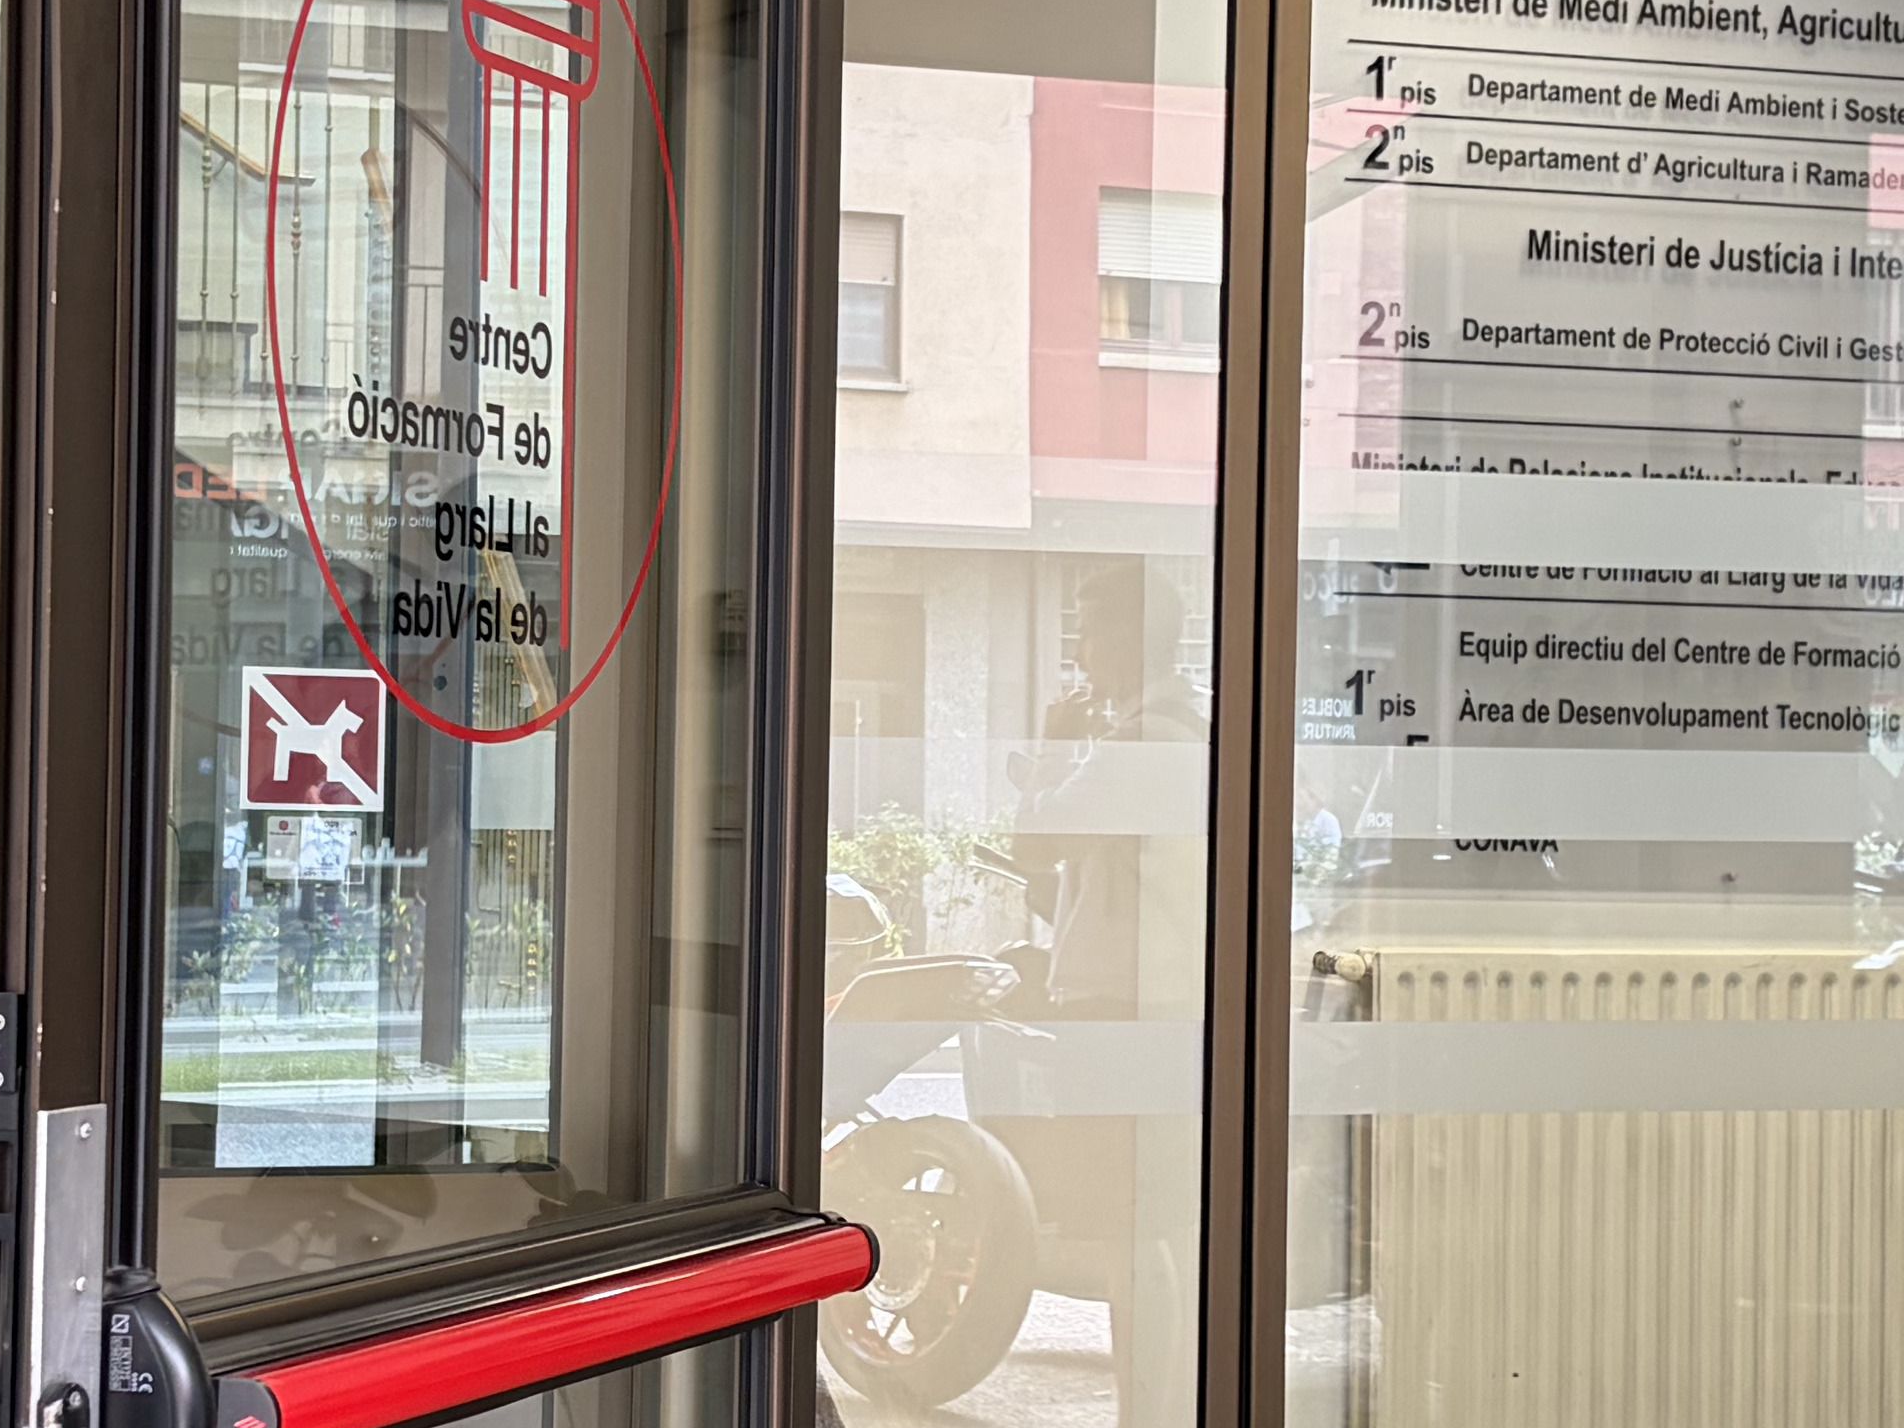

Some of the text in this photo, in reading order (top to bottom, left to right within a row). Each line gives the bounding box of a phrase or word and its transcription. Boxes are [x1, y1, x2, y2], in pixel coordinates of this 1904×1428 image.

[1400, 81, 1437, 108] pis
[1468, 74, 1621, 106] Departament
[1629, 85, 1656, 108] de
[1665, 87, 1719, 113] Medi
[1727, 92, 1824, 120] Ambient
[1832, 98, 1837, 120] i
[1399, 149, 1434, 175] pis
[1466, 141, 1620, 174] Departament
[1654, 153, 1784, 183] Agricultura
[1793, 161, 1797, 183] i
[1527, 229, 1655, 266] Ministeri
[1665, 237, 1700, 269] de
[1709, 240, 1823, 276] Justícia
[1834, 246, 1840, 276] i
[1395, 326, 1430, 351] pis
[1462, 318, 1616, 348] Departament
[1623, 327, 1651, 350] de
[1660, 328, 1770, 355] Protecció
[1778, 334, 1828, 359] Civil
[1836, 337, 1841, 359] i
[1459, 631, 1528, 664] Equip
[1536, 634, 1623, 661] directiu
[1632, 637, 1666, 662] del
[1674, 638, 1751, 665] Centre
[1758, 641, 1785, 666] de
[1794, 641, 1901, 669] Formació
[1380, 693, 1416, 722] pis
[1459, 689, 1514, 723] Àrea
[1522, 699, 1550, 724] de
[1558, 698, 1769, 733] Desenvolupament
[1776, 704, 1901, 737] Tecnològic
